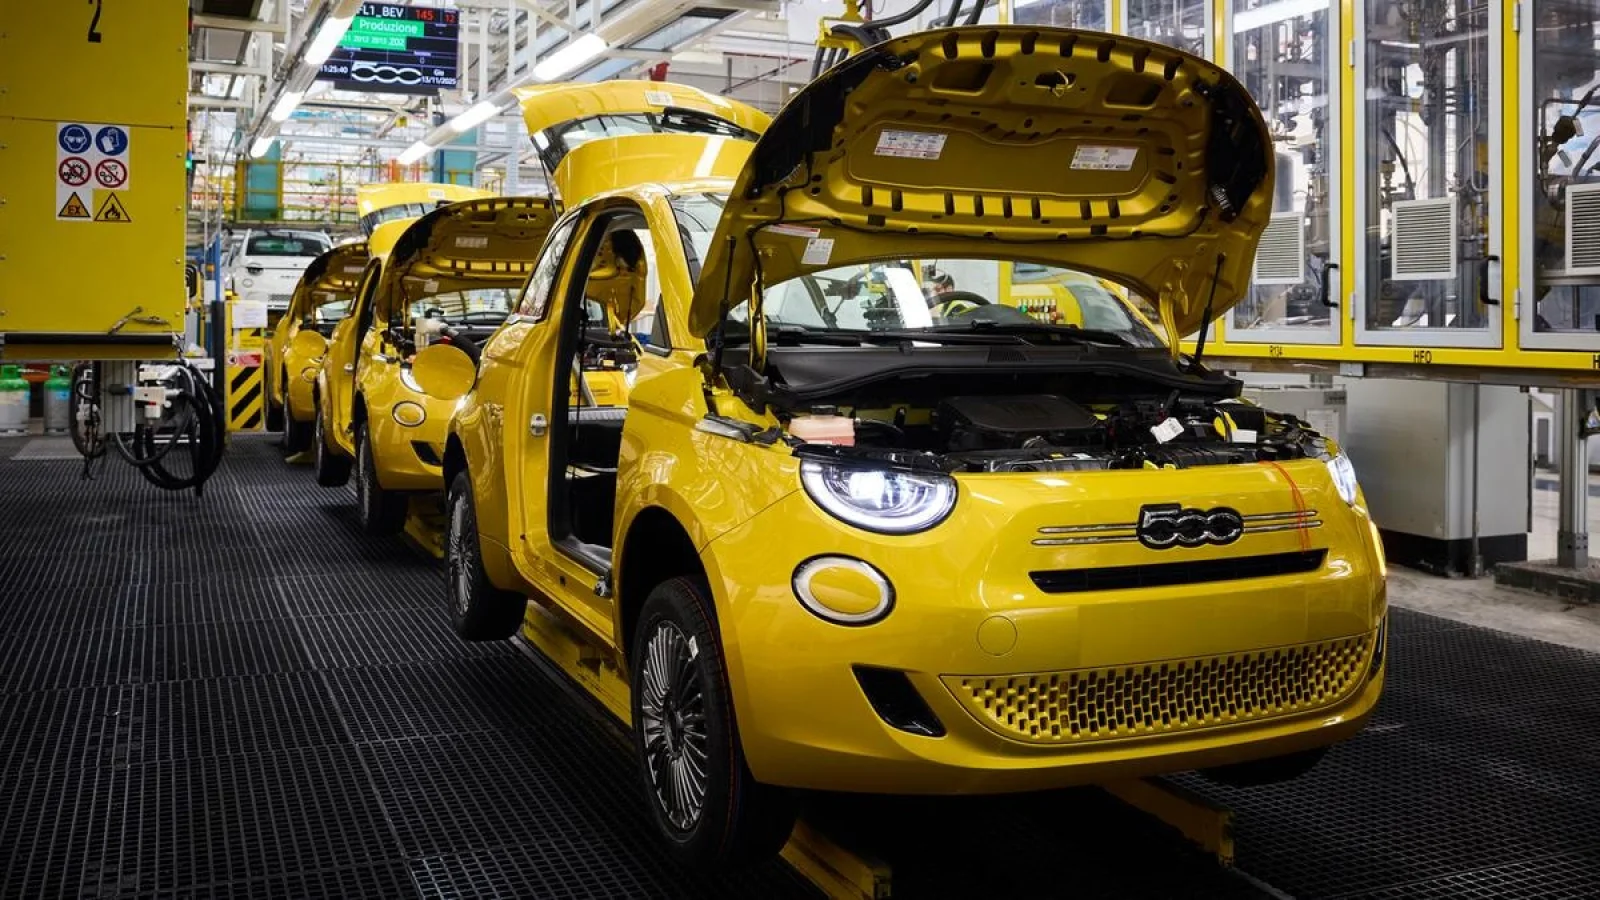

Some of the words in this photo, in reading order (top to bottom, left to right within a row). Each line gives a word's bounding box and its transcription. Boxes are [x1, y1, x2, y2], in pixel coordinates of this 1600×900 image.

[88, 0, 102, 43] 2
[360, 19, 418, 34] Produzione
[68, 204, 81, 216] EX
[1412, 349, 1433, 364] HFO
[1139, 505, 1243, 547] 500
